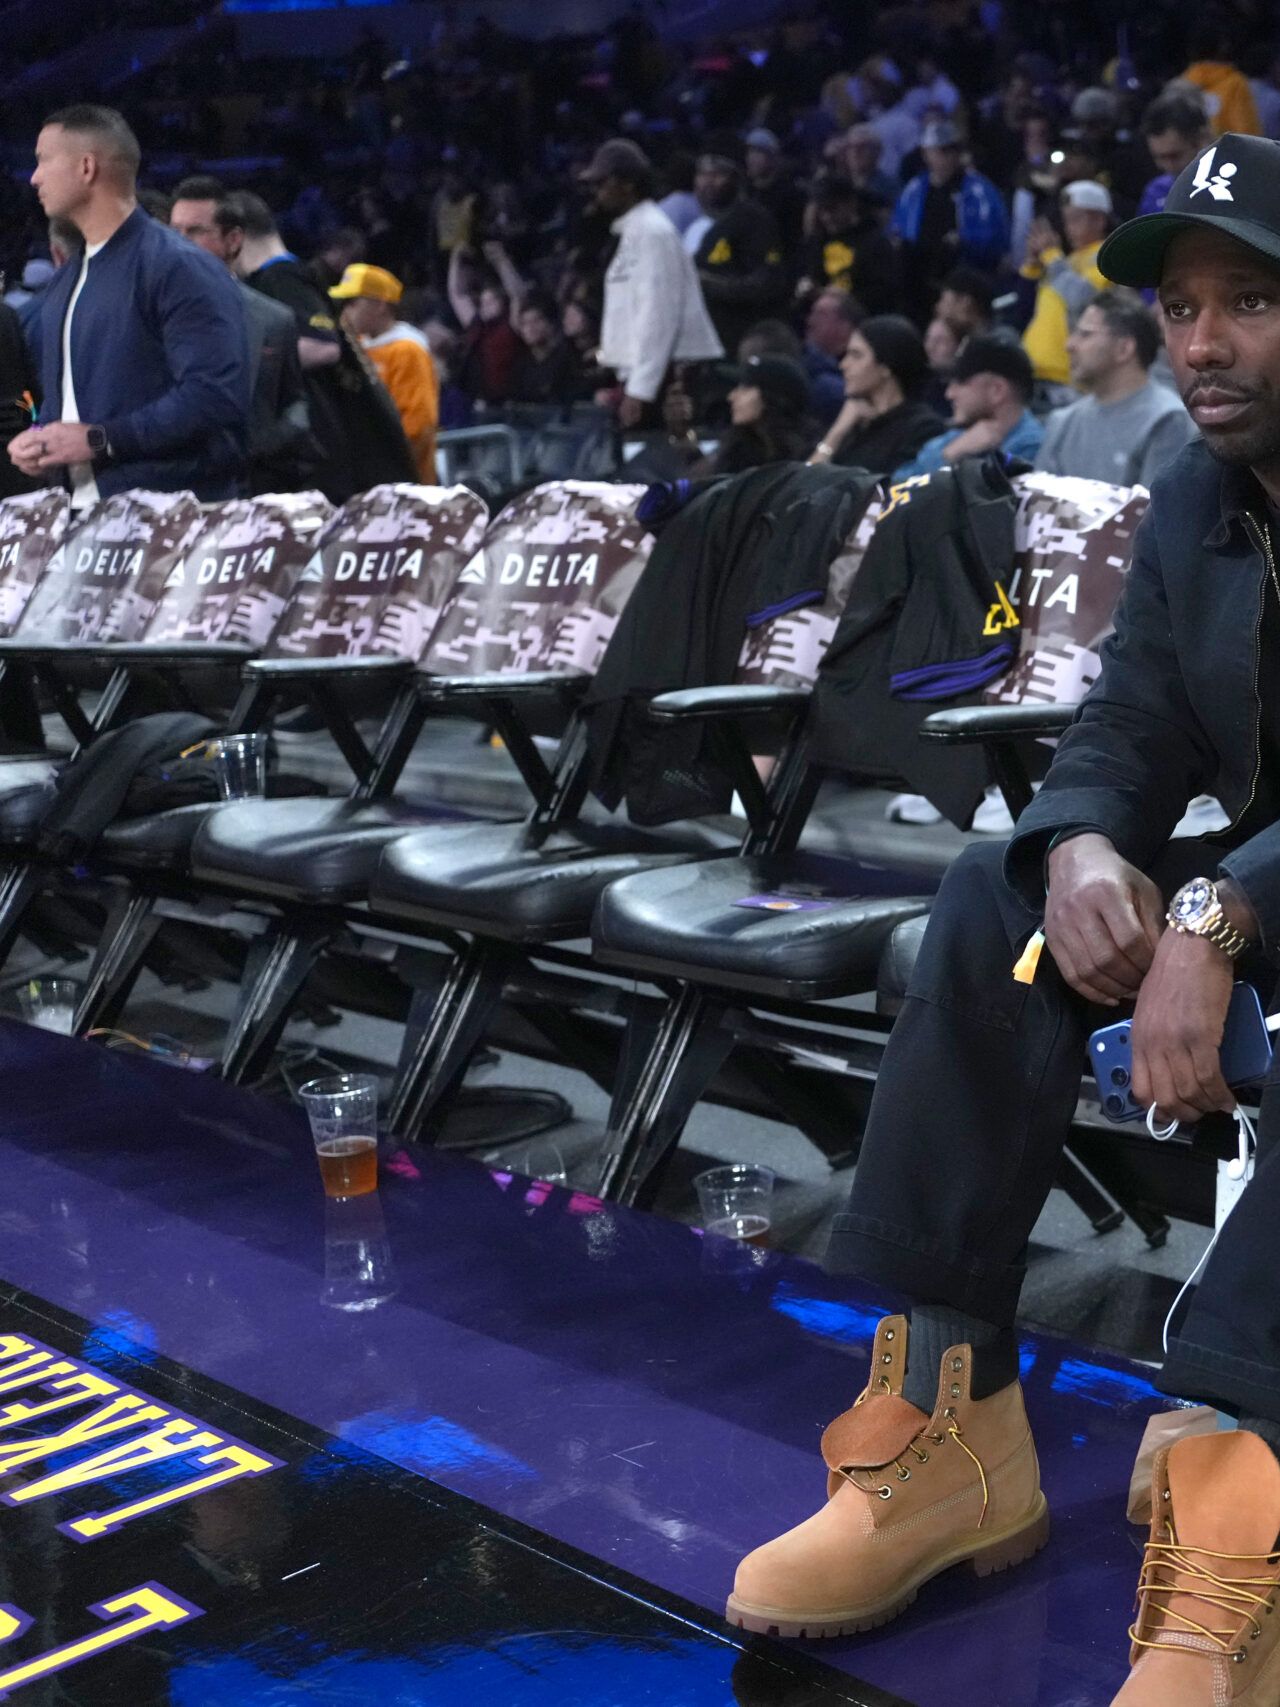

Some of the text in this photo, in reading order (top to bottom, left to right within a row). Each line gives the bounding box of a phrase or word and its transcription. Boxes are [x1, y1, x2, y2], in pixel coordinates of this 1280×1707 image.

[74, 547, 145, 576] DELTA
[196, 546, 276, 585] DELTA
[335, 547, 424, 582] DELTA
[499, 553, 599, 587] DELTA
[0, 1332, 288, 1544] LAKE
